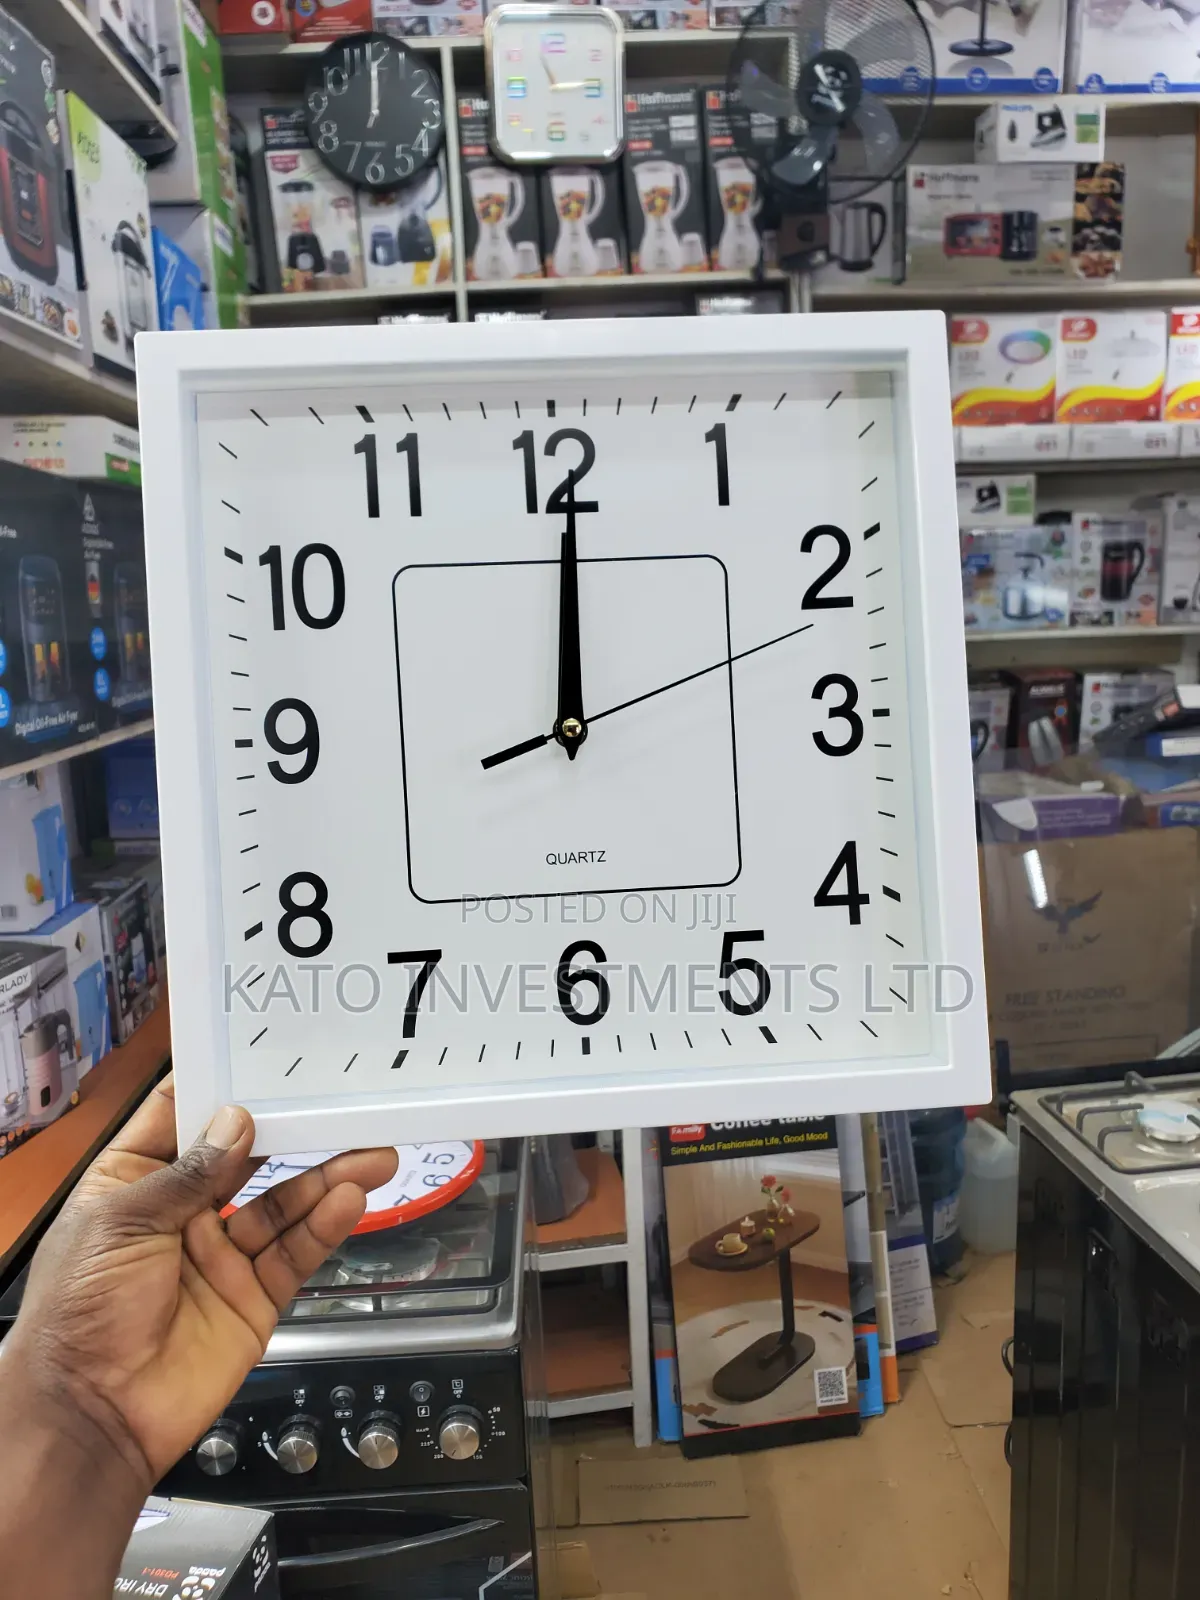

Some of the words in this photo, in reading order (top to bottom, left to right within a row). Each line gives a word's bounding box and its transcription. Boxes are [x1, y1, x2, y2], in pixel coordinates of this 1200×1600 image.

[323, 66, 348, 96] 10
[398, 52, 406, 79] 1
[410, 68, 429, 98] 2
[308, 91, 328, 124] 9
[422, 98, 441, 129] 3
[318, 120, 339, 153] 8
[411, 127, 431, 157] 4
[342, 141, 362, 173] 7
[365, 151, 385, 184] 6
[394, 143, 414, 177] 5
[354, 428, 421, 519] 11
[513, 428, 599, 514] 12
[705, 423, 730, 506] 1
[800, 525, 853, 610] 2
[259, 543, 345, 630] 10
[811, 674, 863, 756] 3
[264, 698, 319, 784] 9
[545, 850, 606, 865] QUARTZ
[814, 841, 870, 925] 4
[278, 872, 333, 958] 8
[557, 940, 610, 1025] 6
[719, 930, 770, 1016] 5
[388, 949, 442, 1038] 7
[671, 1145, 698, 1156] Simple
[699, 1142, 716, 1152] And
[717, 1138, 764, 1151] Fashionable
[783, 1134, 805, 1144] Good
[806, 1131, 829, 1141] Mood
[189, 1566, 226, 1577] panda
[135, 1582, 169, 1597] DRY
